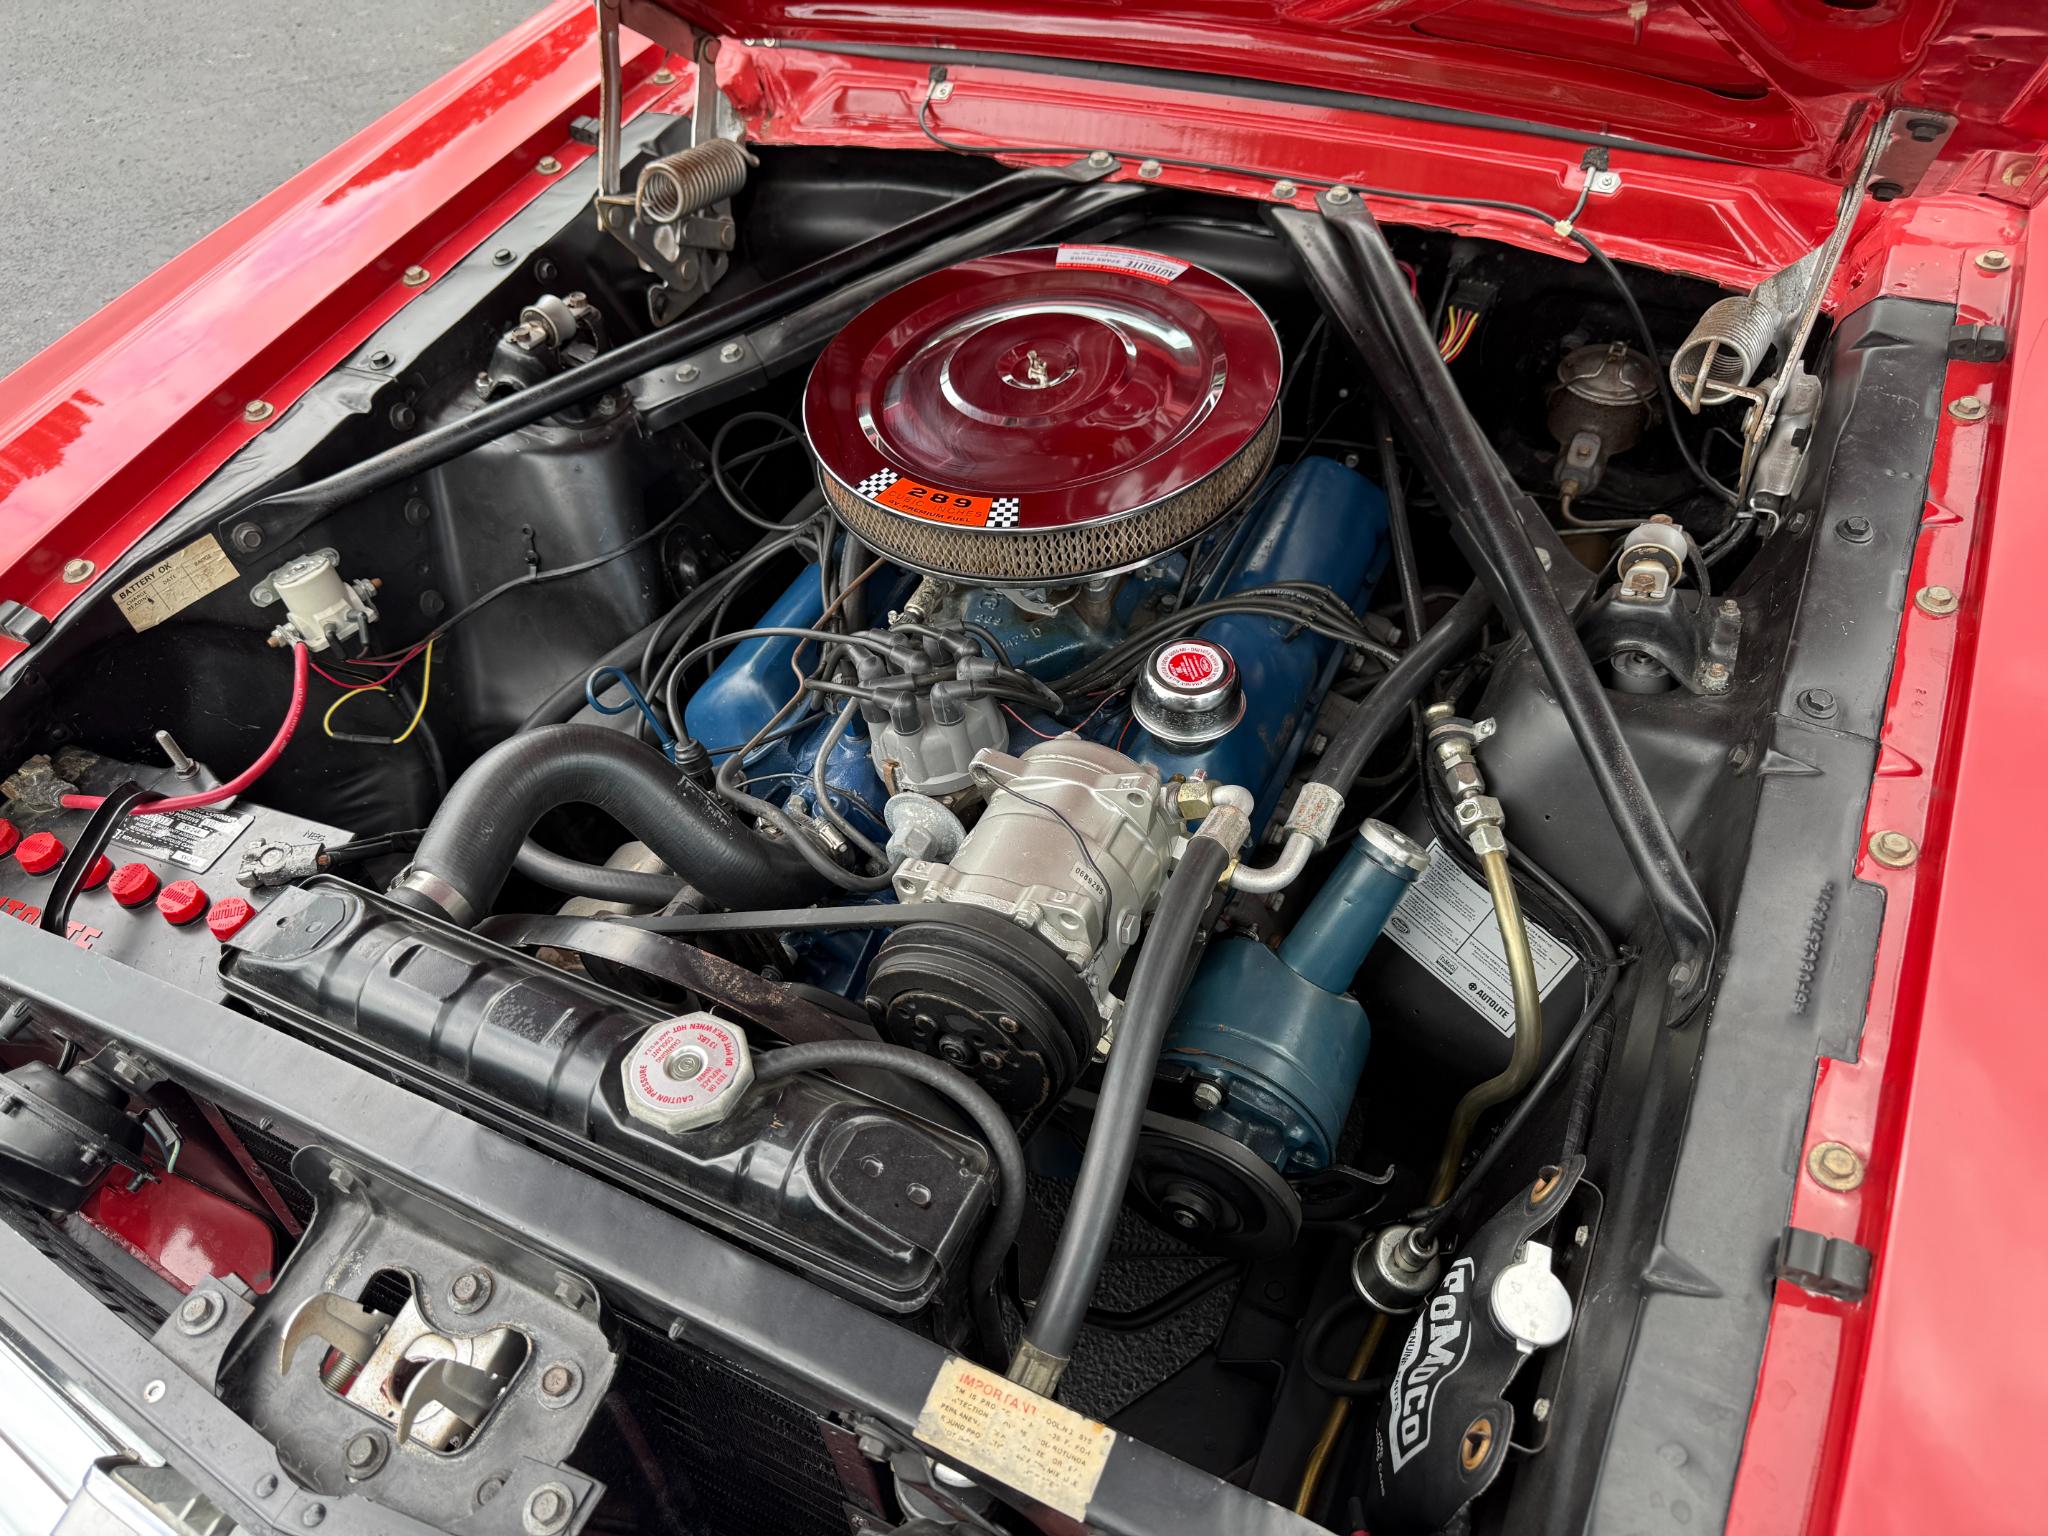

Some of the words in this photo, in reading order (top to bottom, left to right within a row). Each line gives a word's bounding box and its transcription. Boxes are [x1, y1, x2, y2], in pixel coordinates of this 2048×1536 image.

[1124, 261, 1176, 277] AUTOLITE
[889, 490, 924, 507] CUBIC
[932, 503, 983, 518] INCHES
[907, 487, 972, 508] 289
[947, 515, 970, 523] FUEL
[119, 571, 156, 600] BATTERY
[158, 562, 172, 575] OK
[126, 590, 148, 607] CHARGE
[173, 812, 200, 824] POSITIVE
[209, 905, 245, 922] AUTOLITE
[1476, 989, 1510, 1019] AUTOLITE
[673, 1024, 687, 1034] HOT
[690, 1023, 713, 1032] WHEN
[652, 1036, 674, 1058] COOLANT
[697, 1034, 710, 1046] LBS
[725, 1057, 733, 1067] DO
[696, 1066, 713, 1082] WHEN
[700, 1068, 722, 1089] REPLACE
[715, 1072, 728, 1085] TEST
[640, 1065, 659, 1098] PRESSURE
[707, 1085, 717, 1093] OR
[657, 1094, 694, 1104] CAUTION
[969, 1393, 977, 1401] IS
[1052, 1458, 1063, 1467] OR
